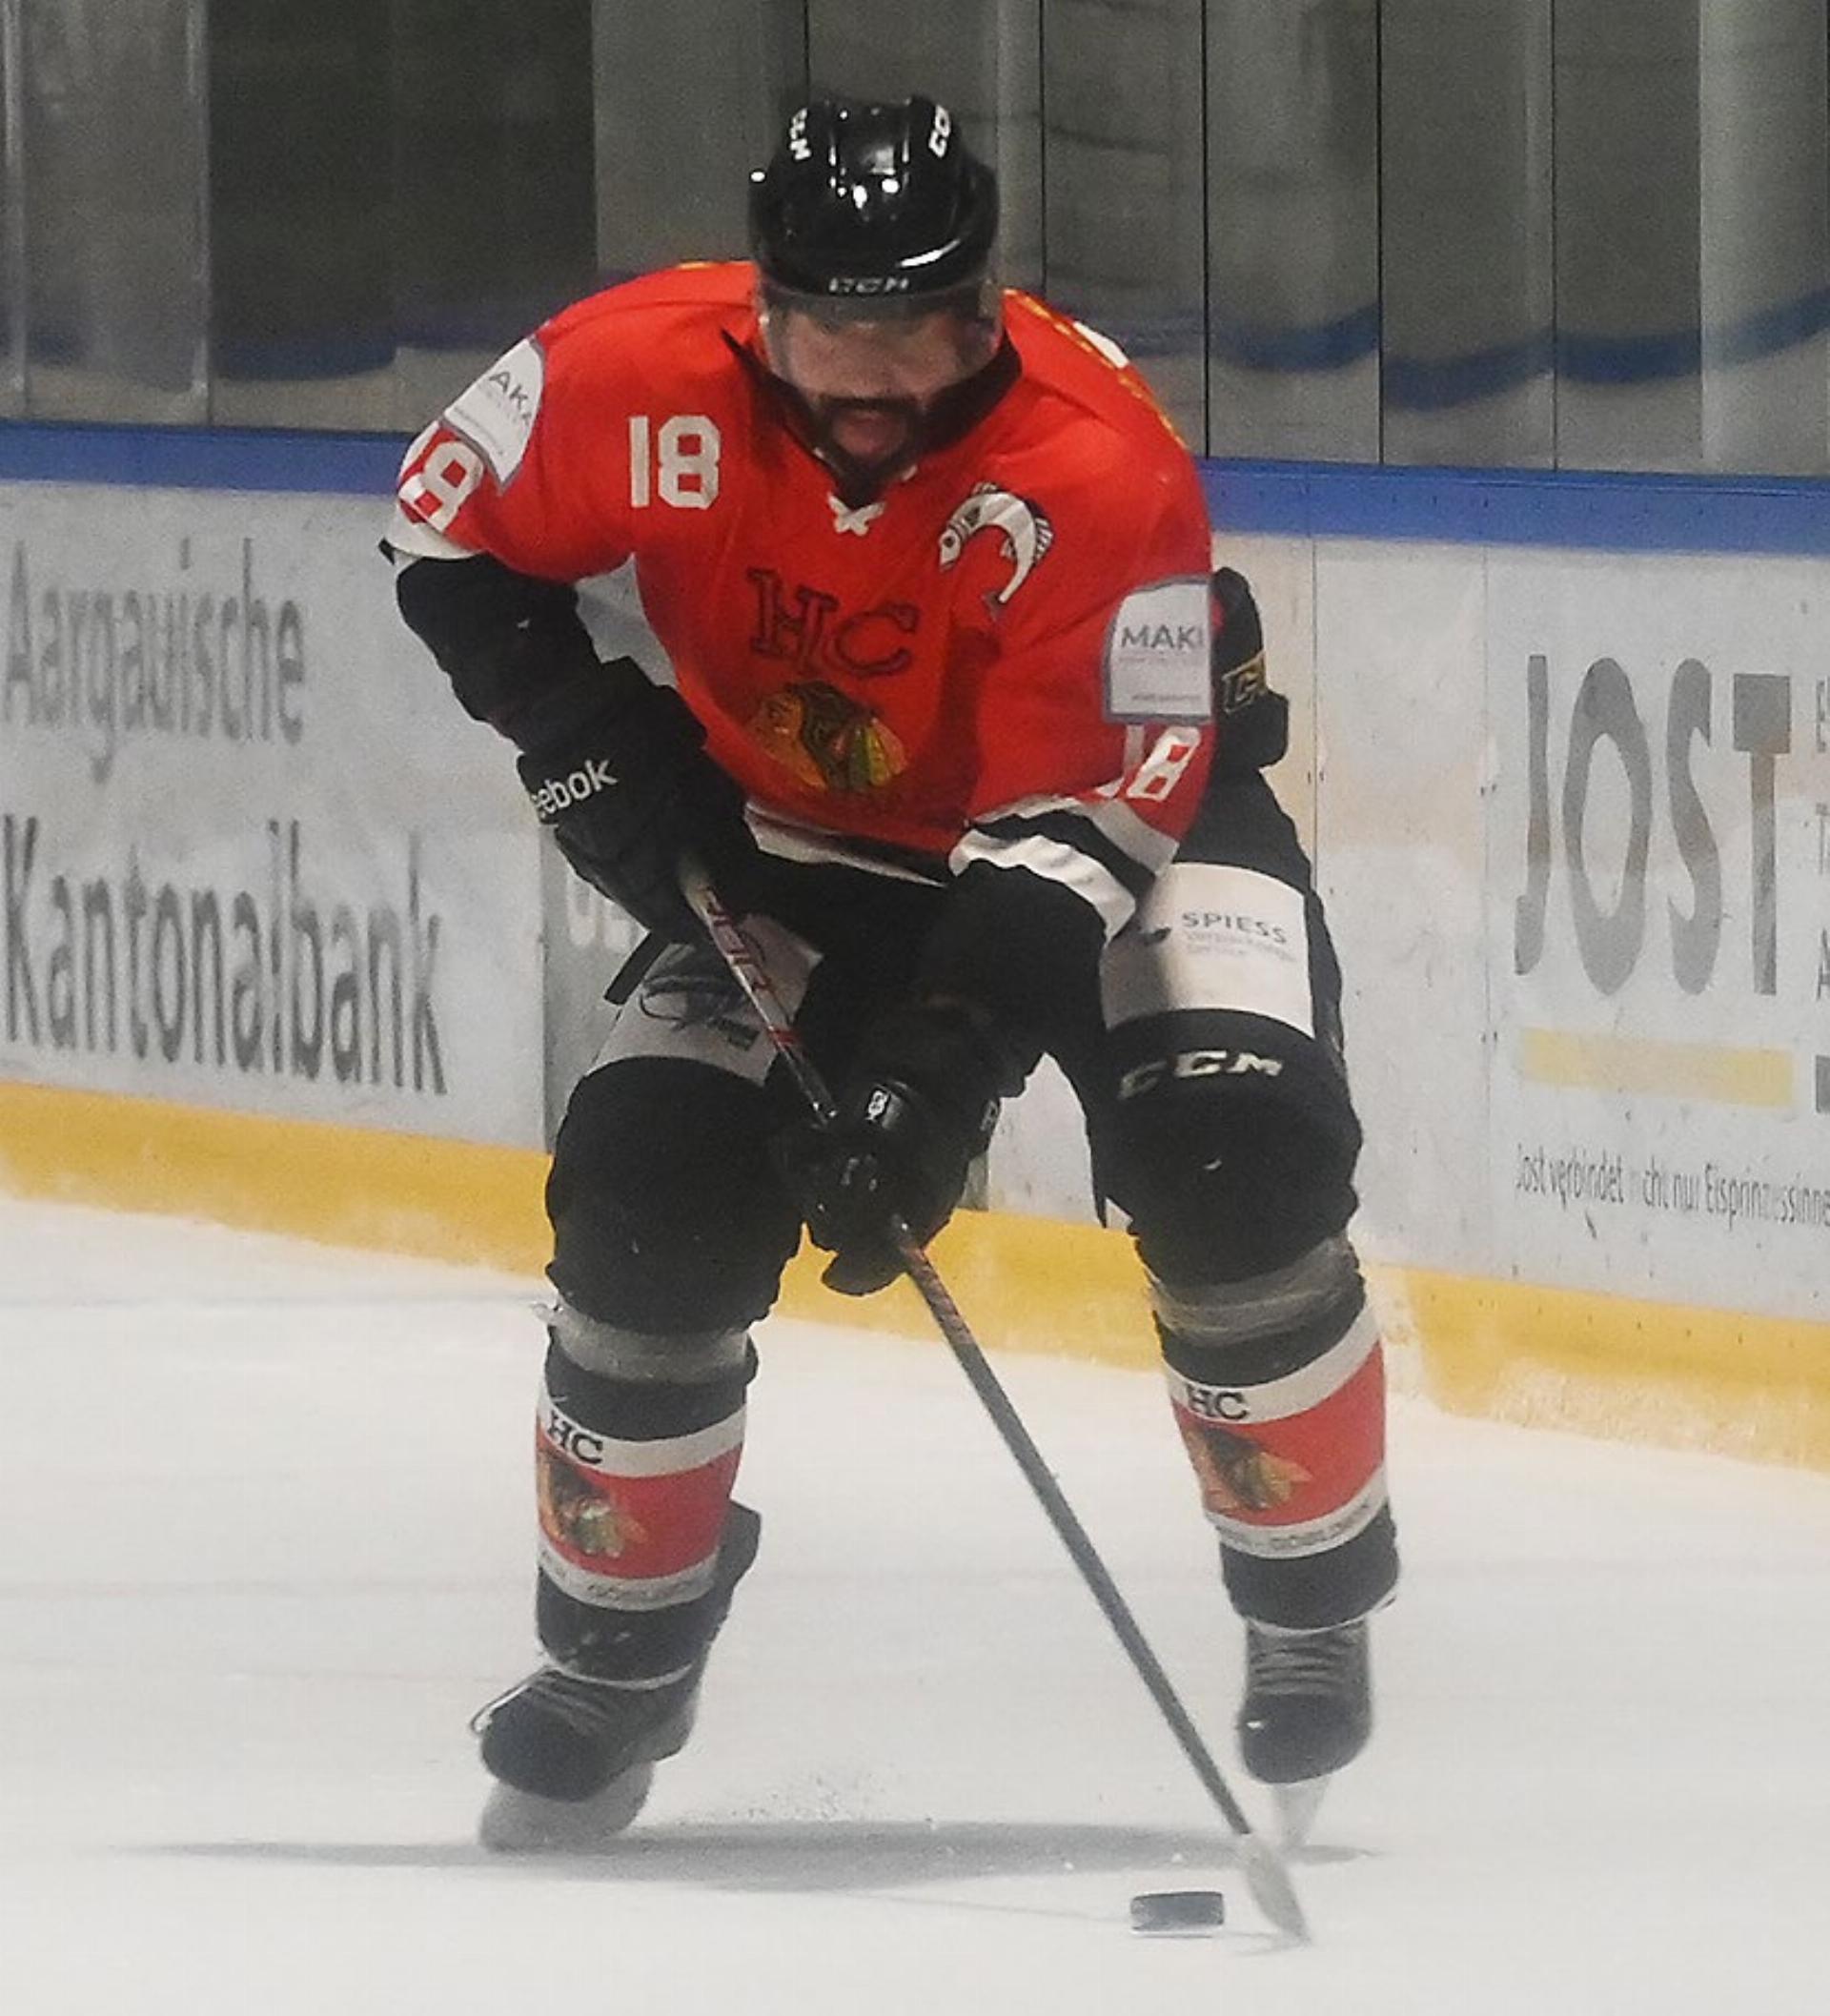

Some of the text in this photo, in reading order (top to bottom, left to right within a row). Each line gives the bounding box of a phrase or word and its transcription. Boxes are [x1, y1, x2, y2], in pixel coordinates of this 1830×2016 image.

[629, 415, 721, 509] 18
[3, 537, 305, 783] Aargauische
[745, 568, 921, 679] HC
[1514, 654, 1790, 996] JOST
[3, 812, 448, 1095] Kantonalbank
[1182, 912, 1288, 944] SPIESS
[1118, 1049, 1283, 1096] CCM
[546, 1411, 603, 1464] HC
[1186, 1384, 1249, 1420] HC
